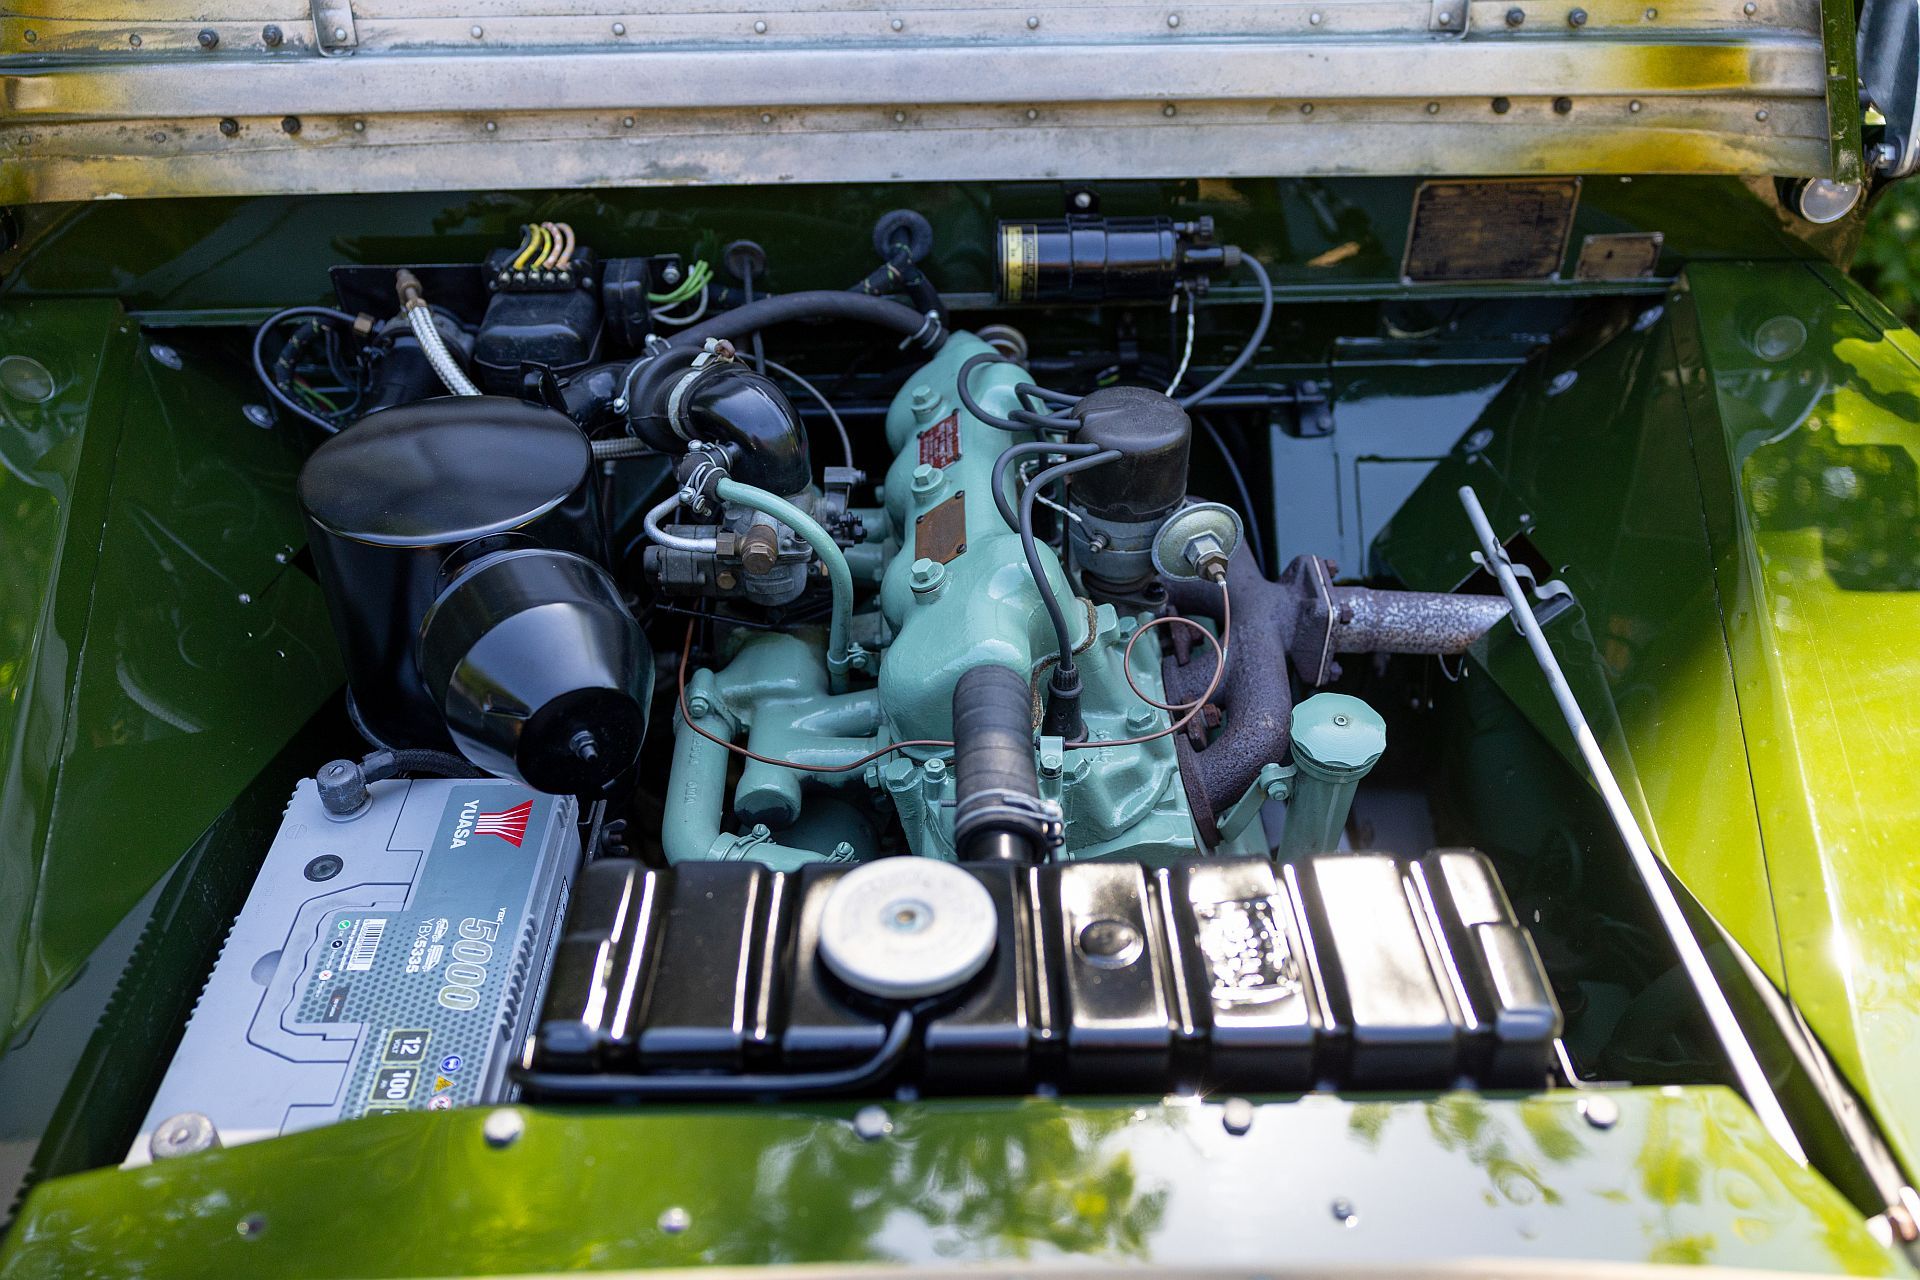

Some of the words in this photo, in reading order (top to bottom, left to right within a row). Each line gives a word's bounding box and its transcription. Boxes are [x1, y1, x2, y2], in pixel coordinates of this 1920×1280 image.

[449, 799, 480, 850] YUASA
[405, 917, 435, 974] YBX5335
[438, 917, 500, 1011] 5000
[391, 1038, 402, 1054] VOLT
[400, 1036, 422, 1055] 12
[386, 1070, 412, 1099] 100
